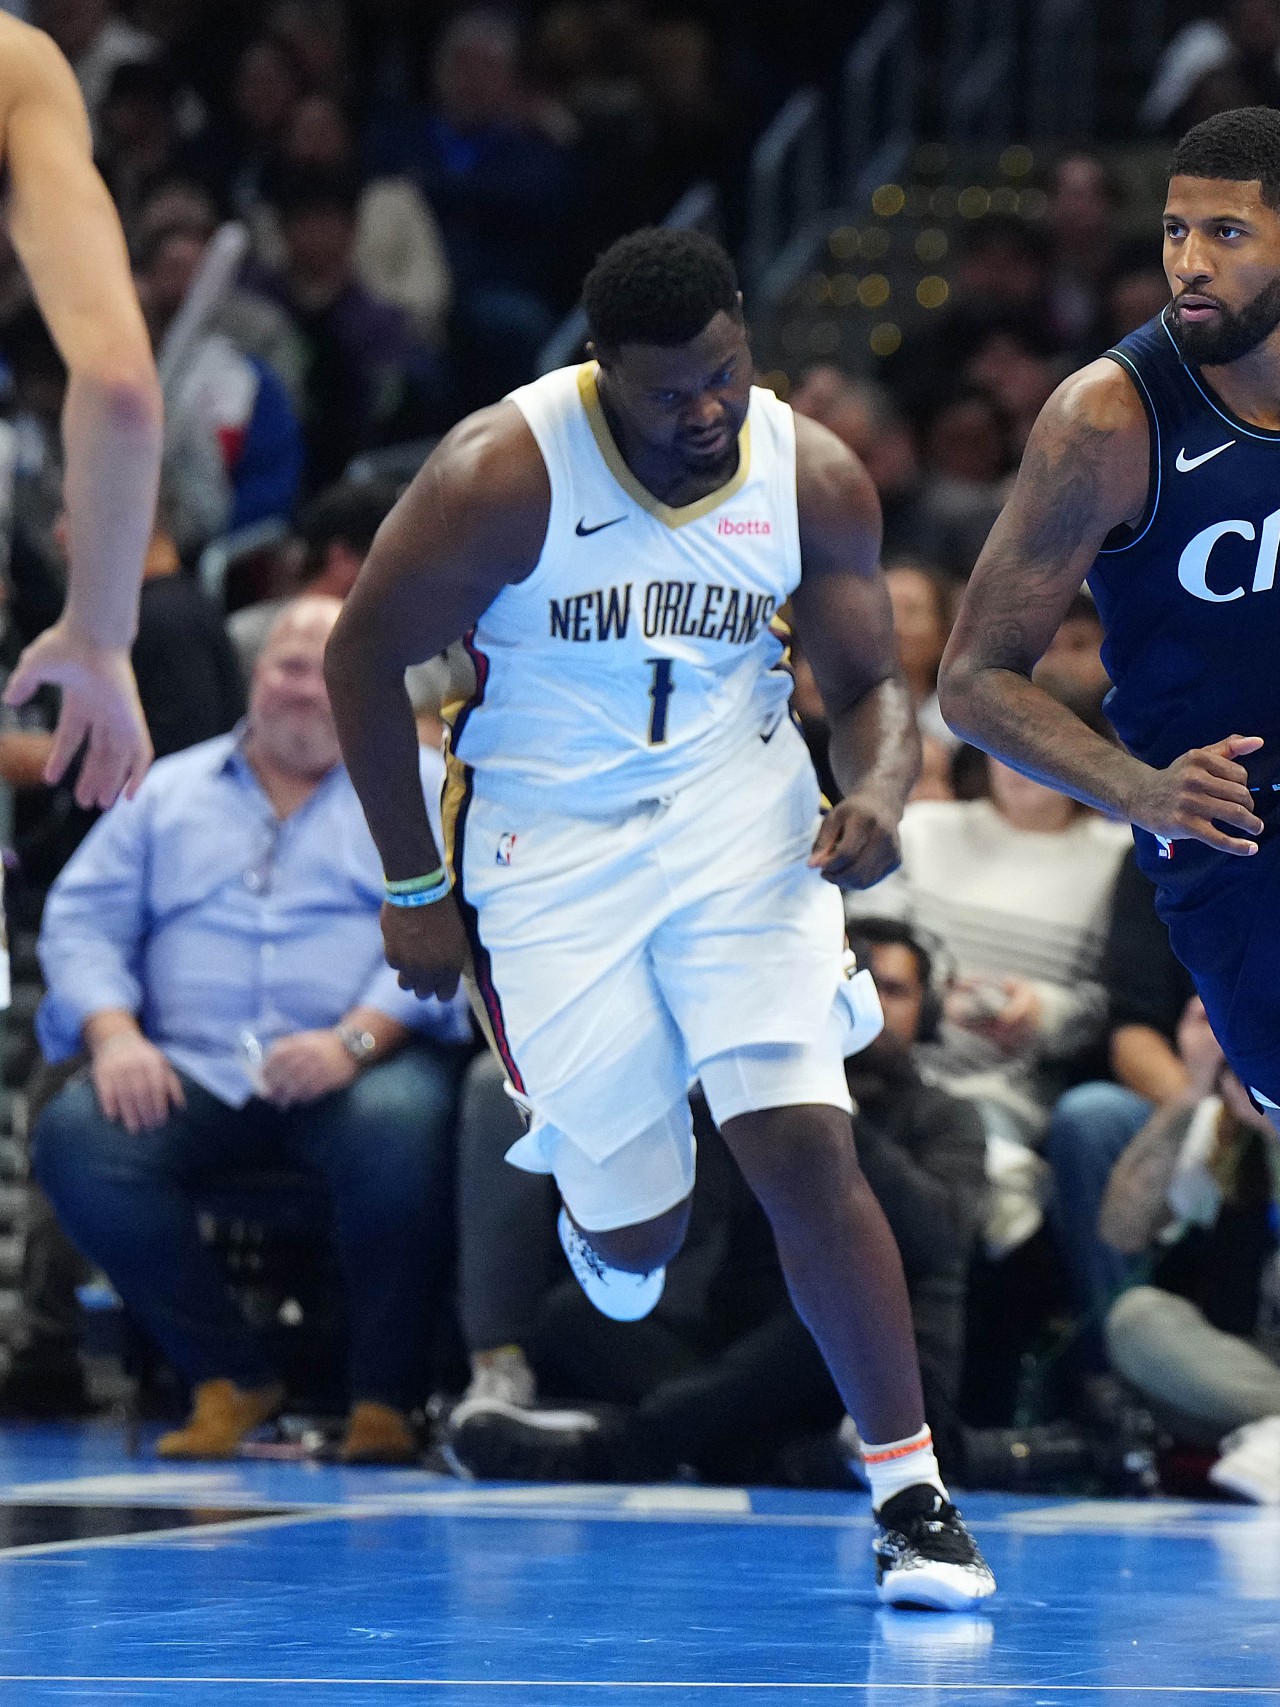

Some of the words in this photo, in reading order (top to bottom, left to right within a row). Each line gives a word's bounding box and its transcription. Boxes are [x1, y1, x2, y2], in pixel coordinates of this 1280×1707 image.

[717, 518, 771, 535] ibotta
[549, 583, 633, 642] NEW
[644, 658, 674, 746] 1
